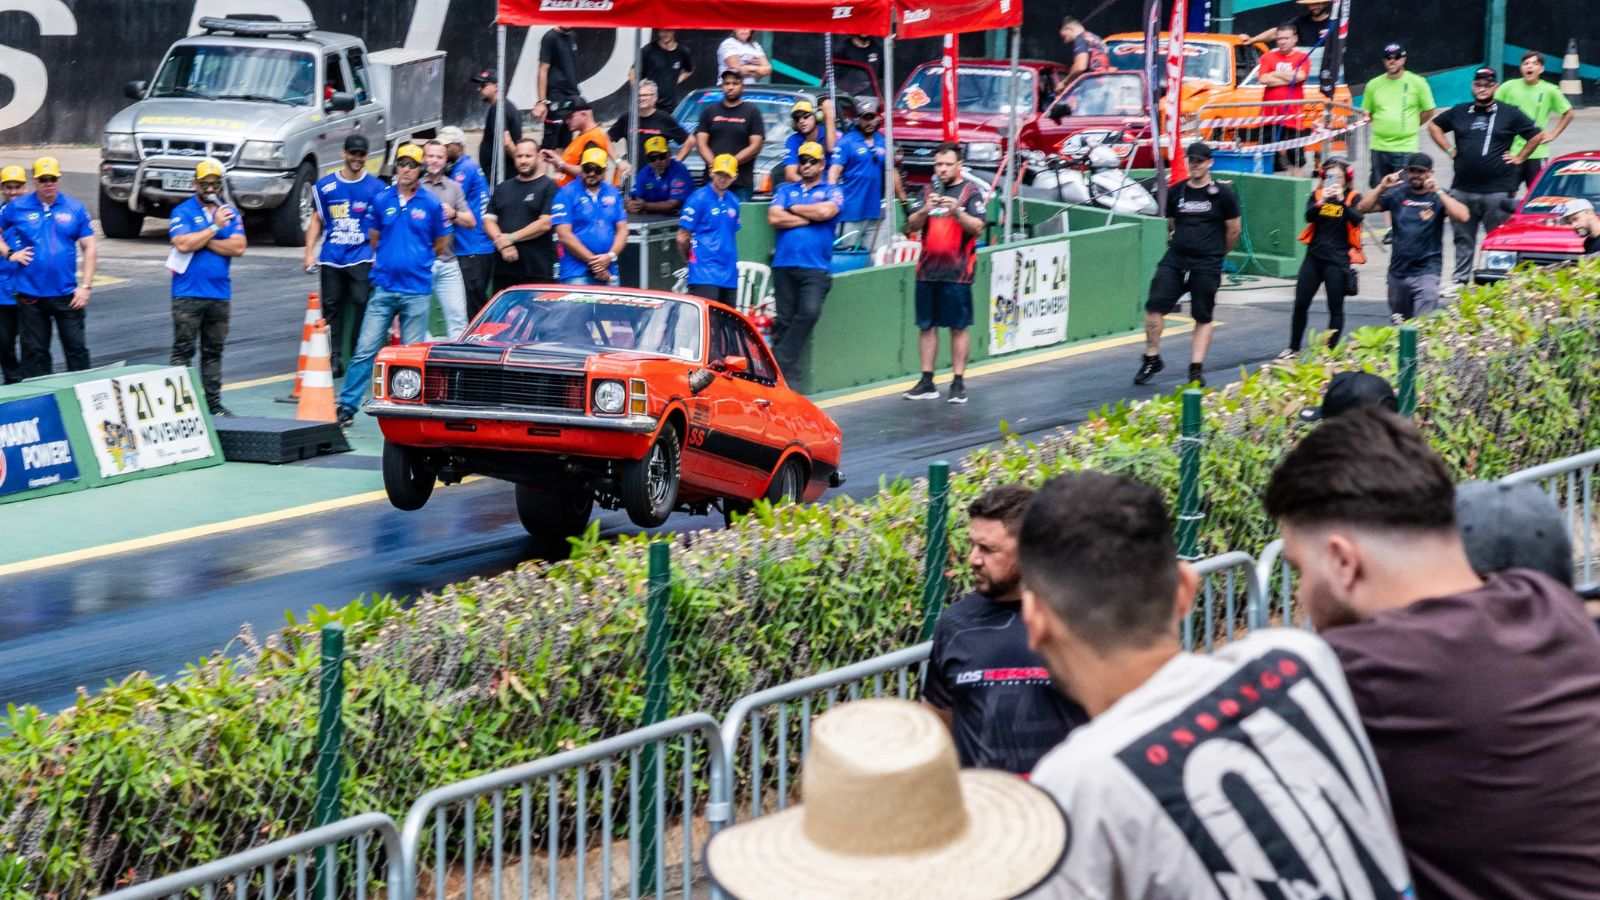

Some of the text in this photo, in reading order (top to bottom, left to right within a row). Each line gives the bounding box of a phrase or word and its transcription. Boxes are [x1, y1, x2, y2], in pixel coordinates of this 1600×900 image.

[1024, 259, 1037, 295] 21
[1052, 254, 1067, 290] 24
[129, 382, 155, 421] 21
[164, 375, 195, 414] 24
[140, 417, 204, 446] NOVEMBRO
[689, 428, 705, 447] SS
[956, 670, 983, 684] LOS
